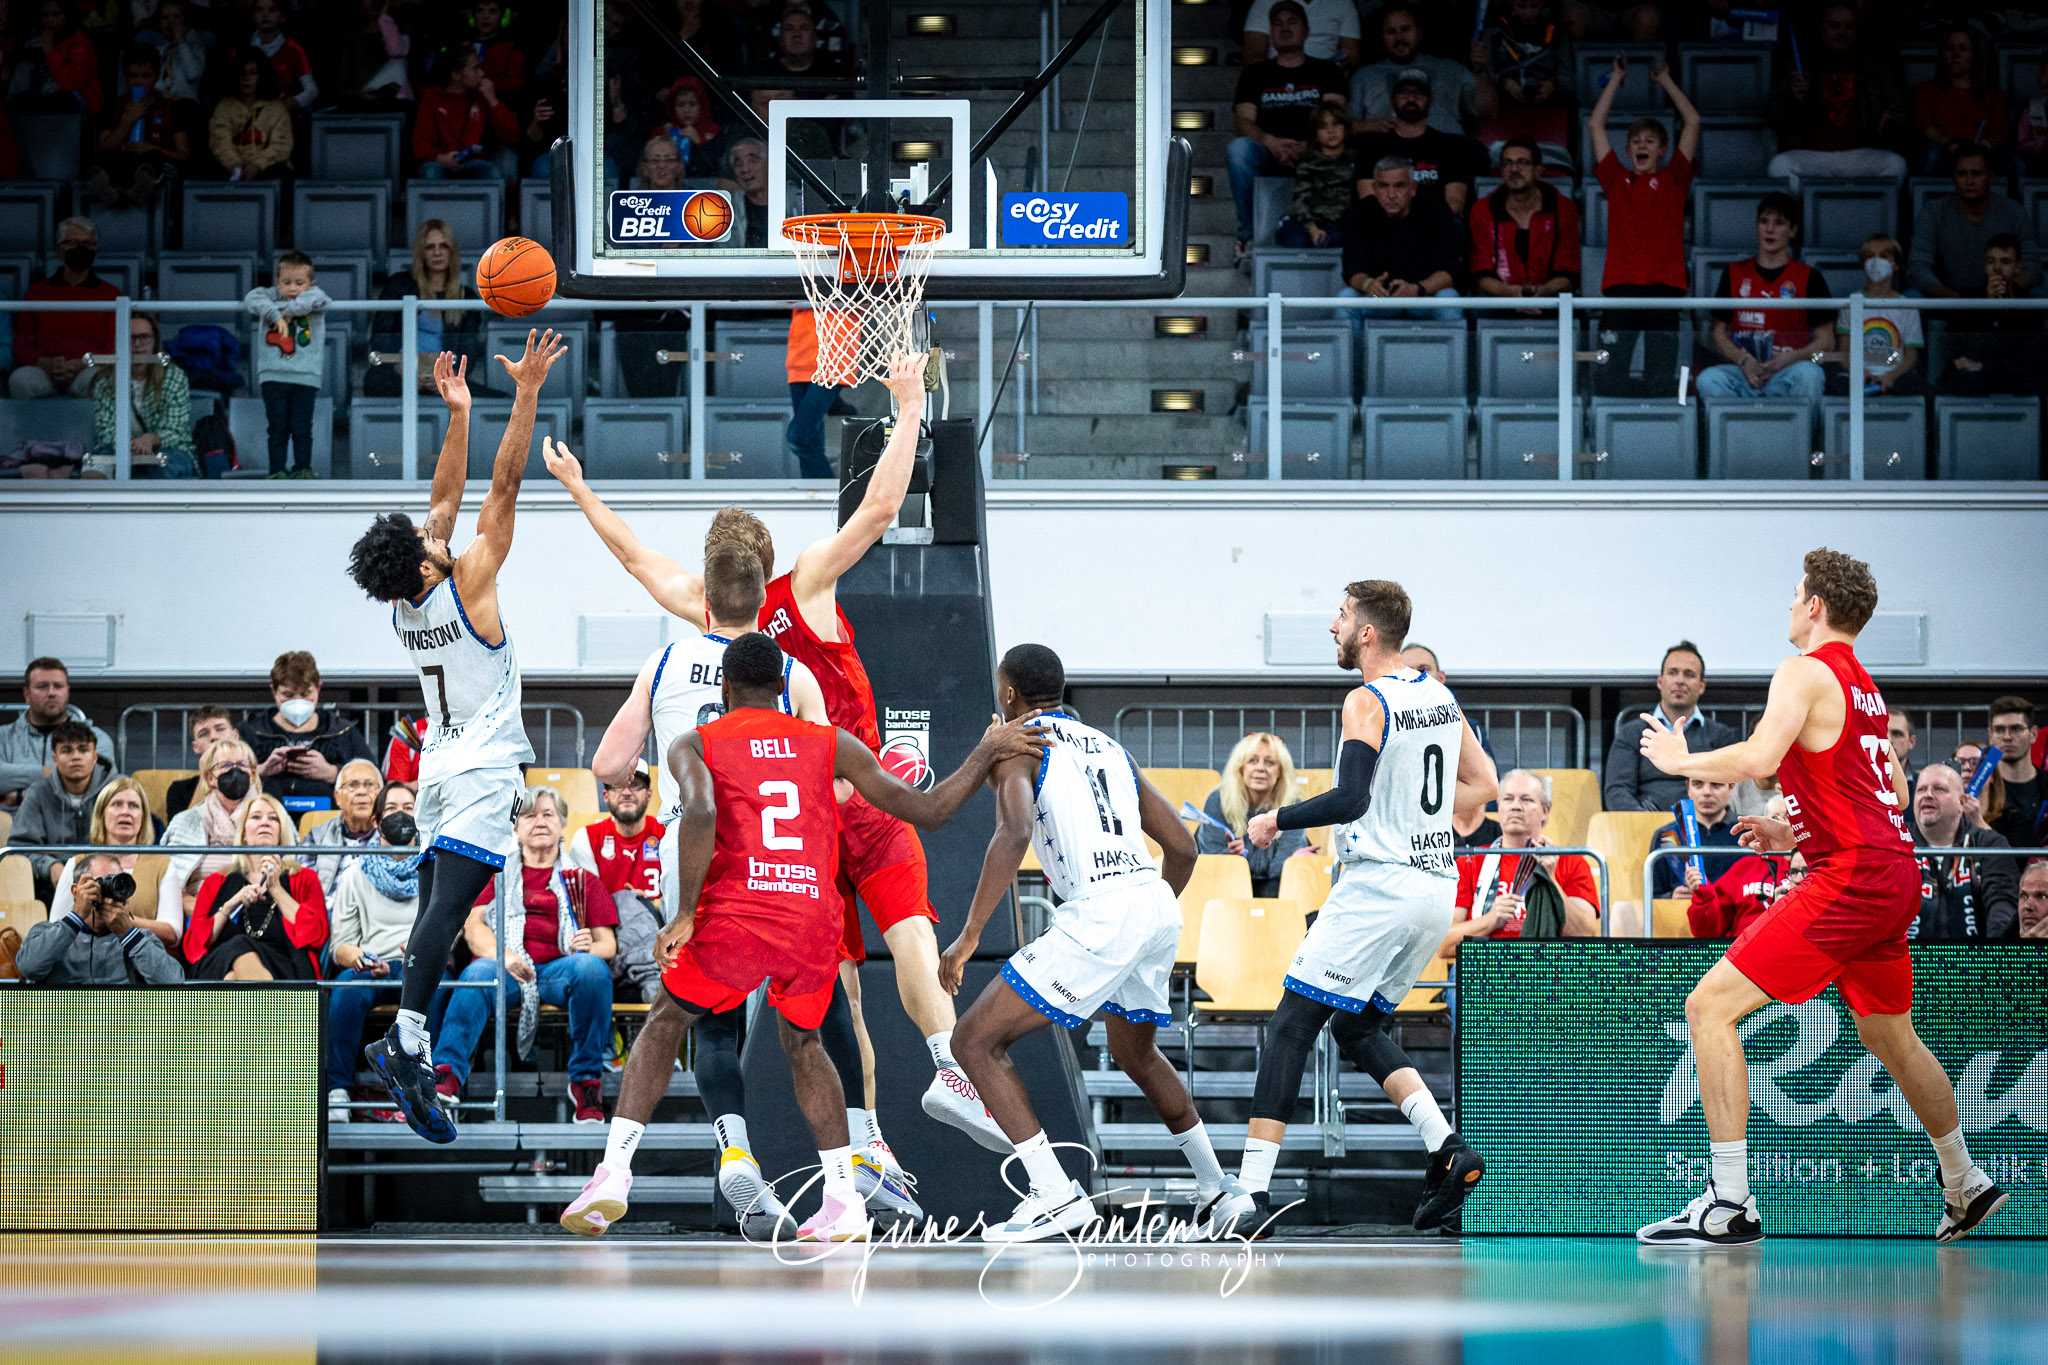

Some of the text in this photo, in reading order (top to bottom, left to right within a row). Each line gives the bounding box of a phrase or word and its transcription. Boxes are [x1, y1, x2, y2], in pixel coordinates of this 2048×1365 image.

[635, 206, 671, 216] Credit
[620, 217, 670, 237] BBL
[1043, 218, 1120, 239] Credit
[690, 663, 723, 686] BLE
[421, 664, 450, 728] 7
[885, 707, 931, 720] brose
[885, 720, 930, 730] bamberg
[750, 738, 797, 758] BELL
[1421, 744, 1443, 815] 0
[758, 780, 803, 850] 2
[1411, 831, 1450, 851] HAKRO
[748, 857, 818, 881] brose
[747, 877, 820, 899] bamberg
[1324, 970, 1352, 985] HAKRO
[1052, 981, 1077, 1003] HAKRO
